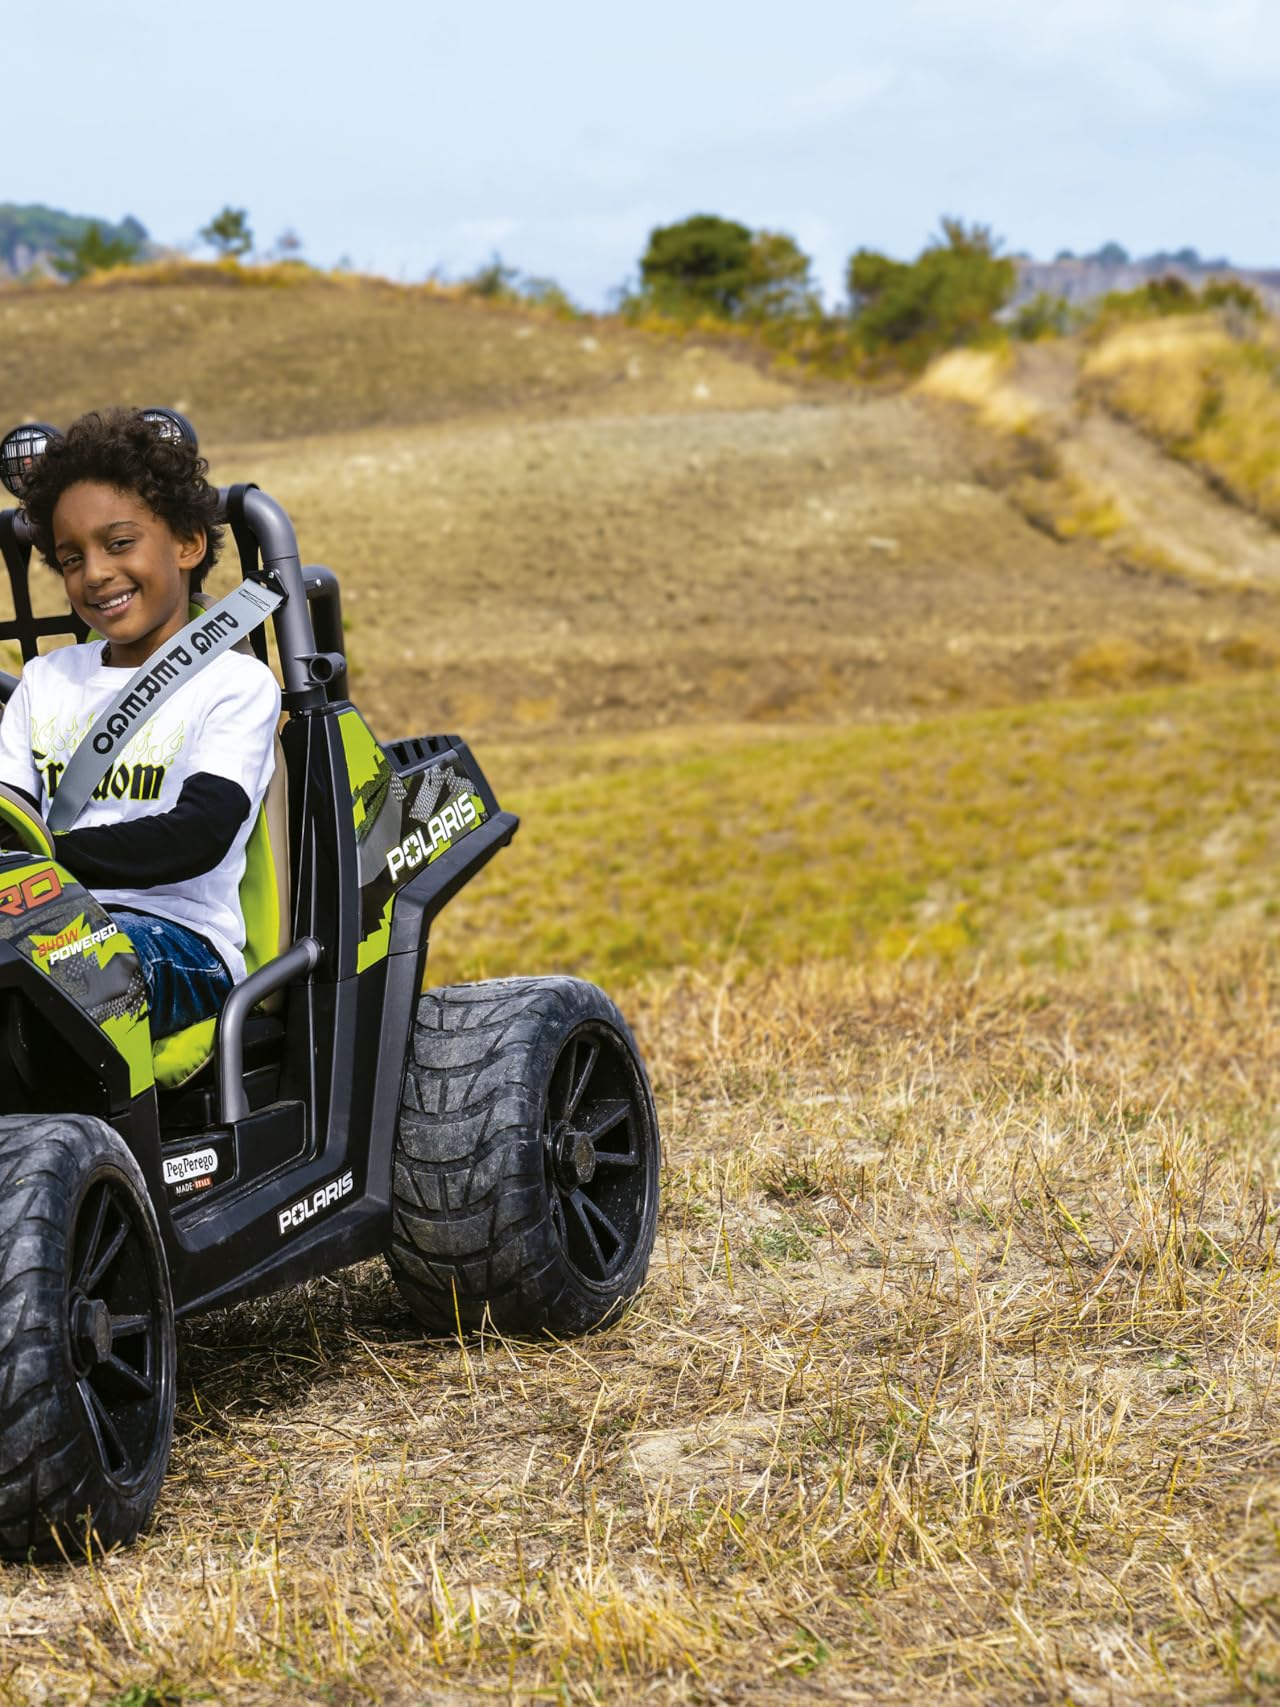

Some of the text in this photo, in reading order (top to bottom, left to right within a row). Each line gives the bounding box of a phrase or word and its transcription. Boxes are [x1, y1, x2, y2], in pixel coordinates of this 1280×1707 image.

[92, 610, 239, 755] PEG PEREGO
[385, 791, 477, 881] POLARIS
[48, 922, 118, 965] POWERED
[278, 1170, 354, 1235] POLARIS
